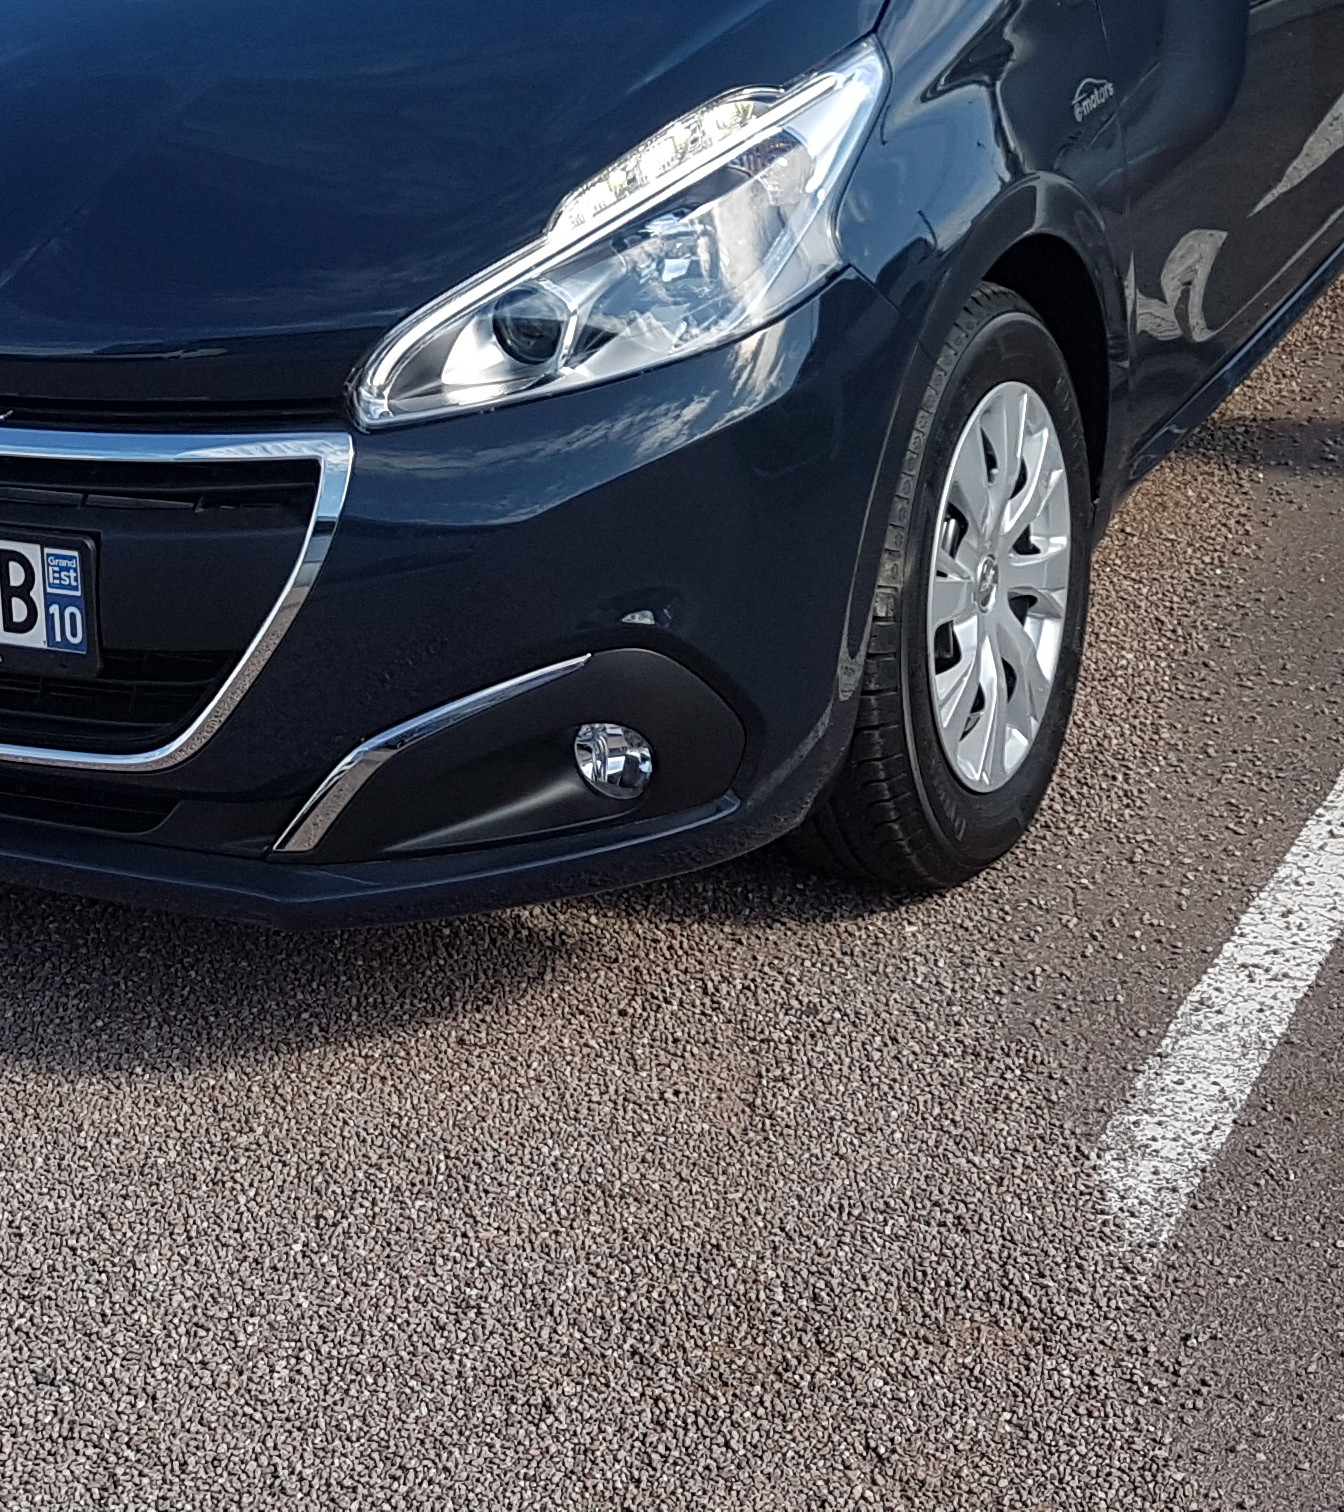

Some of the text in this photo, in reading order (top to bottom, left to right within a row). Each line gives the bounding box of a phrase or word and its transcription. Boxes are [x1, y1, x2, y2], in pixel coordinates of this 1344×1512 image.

[47, 555, 77, 569] Grand
[48, 565, 78, 587] Est
[48, 603, 83, 645] 10
